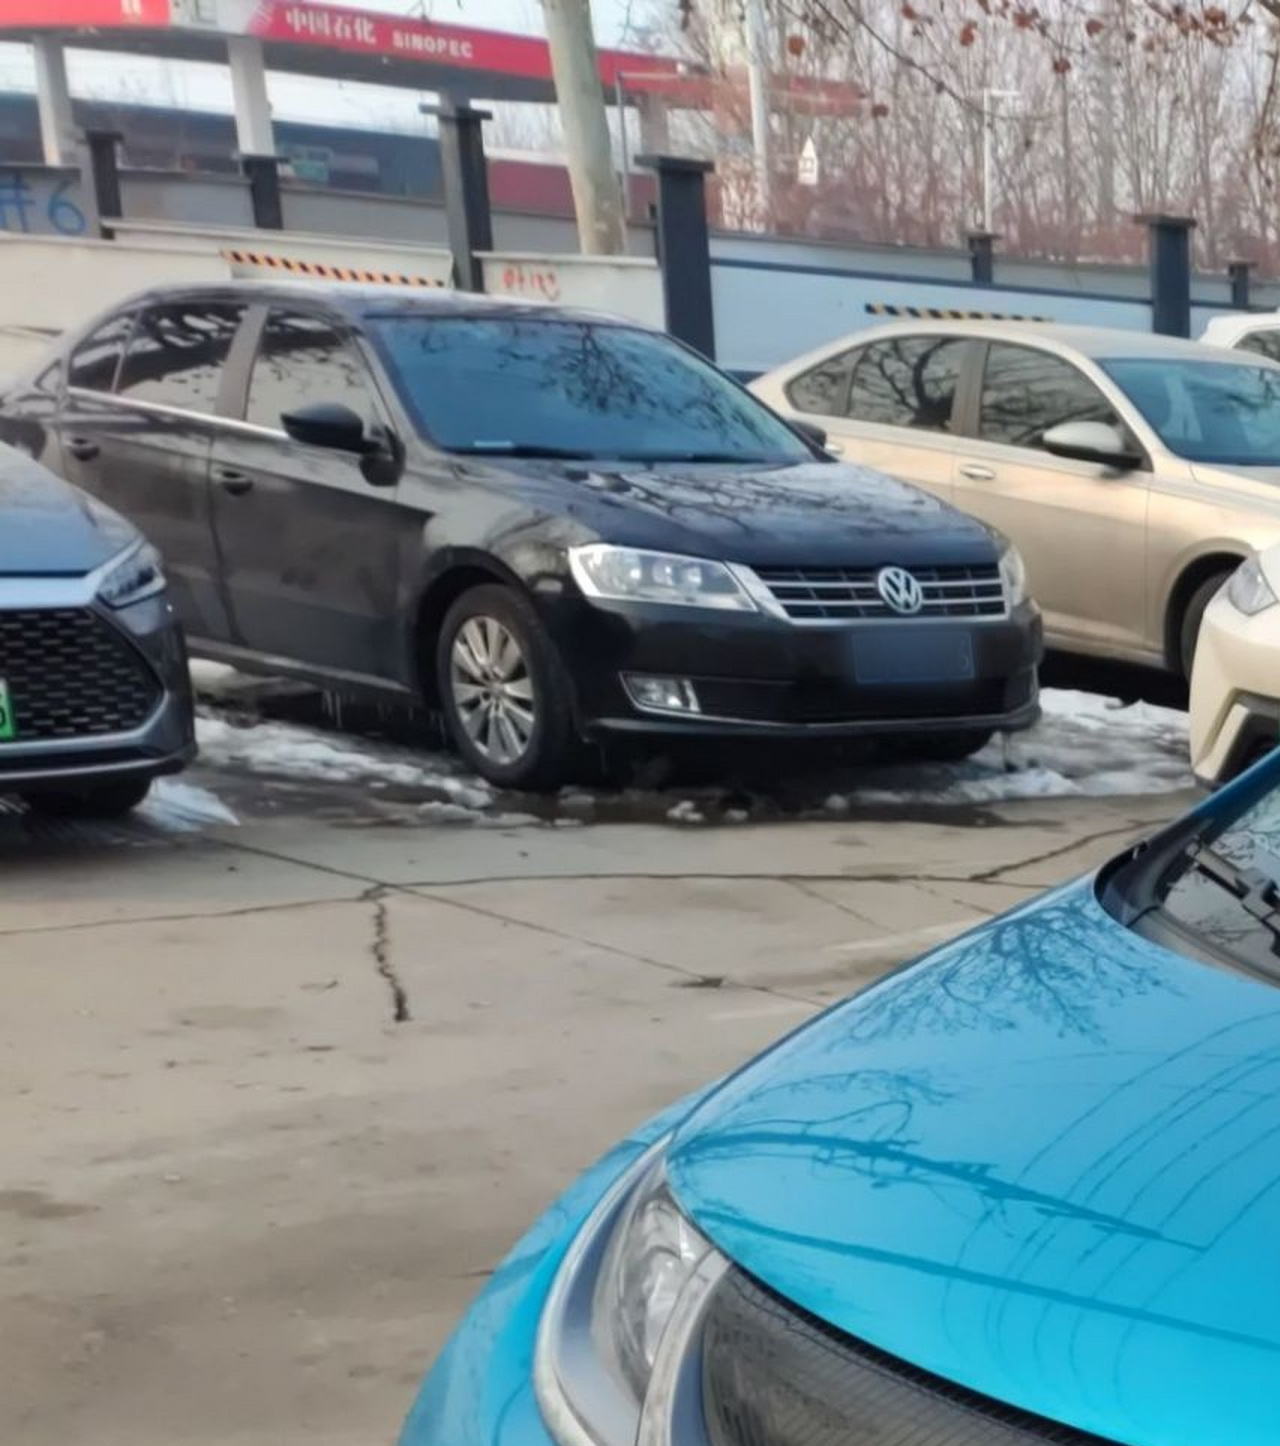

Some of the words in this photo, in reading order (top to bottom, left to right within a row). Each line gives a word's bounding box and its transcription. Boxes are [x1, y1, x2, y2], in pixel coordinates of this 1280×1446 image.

[286, 7, 376, 45] 中国石化
[392, 30, 474, 58] SINOPEC
